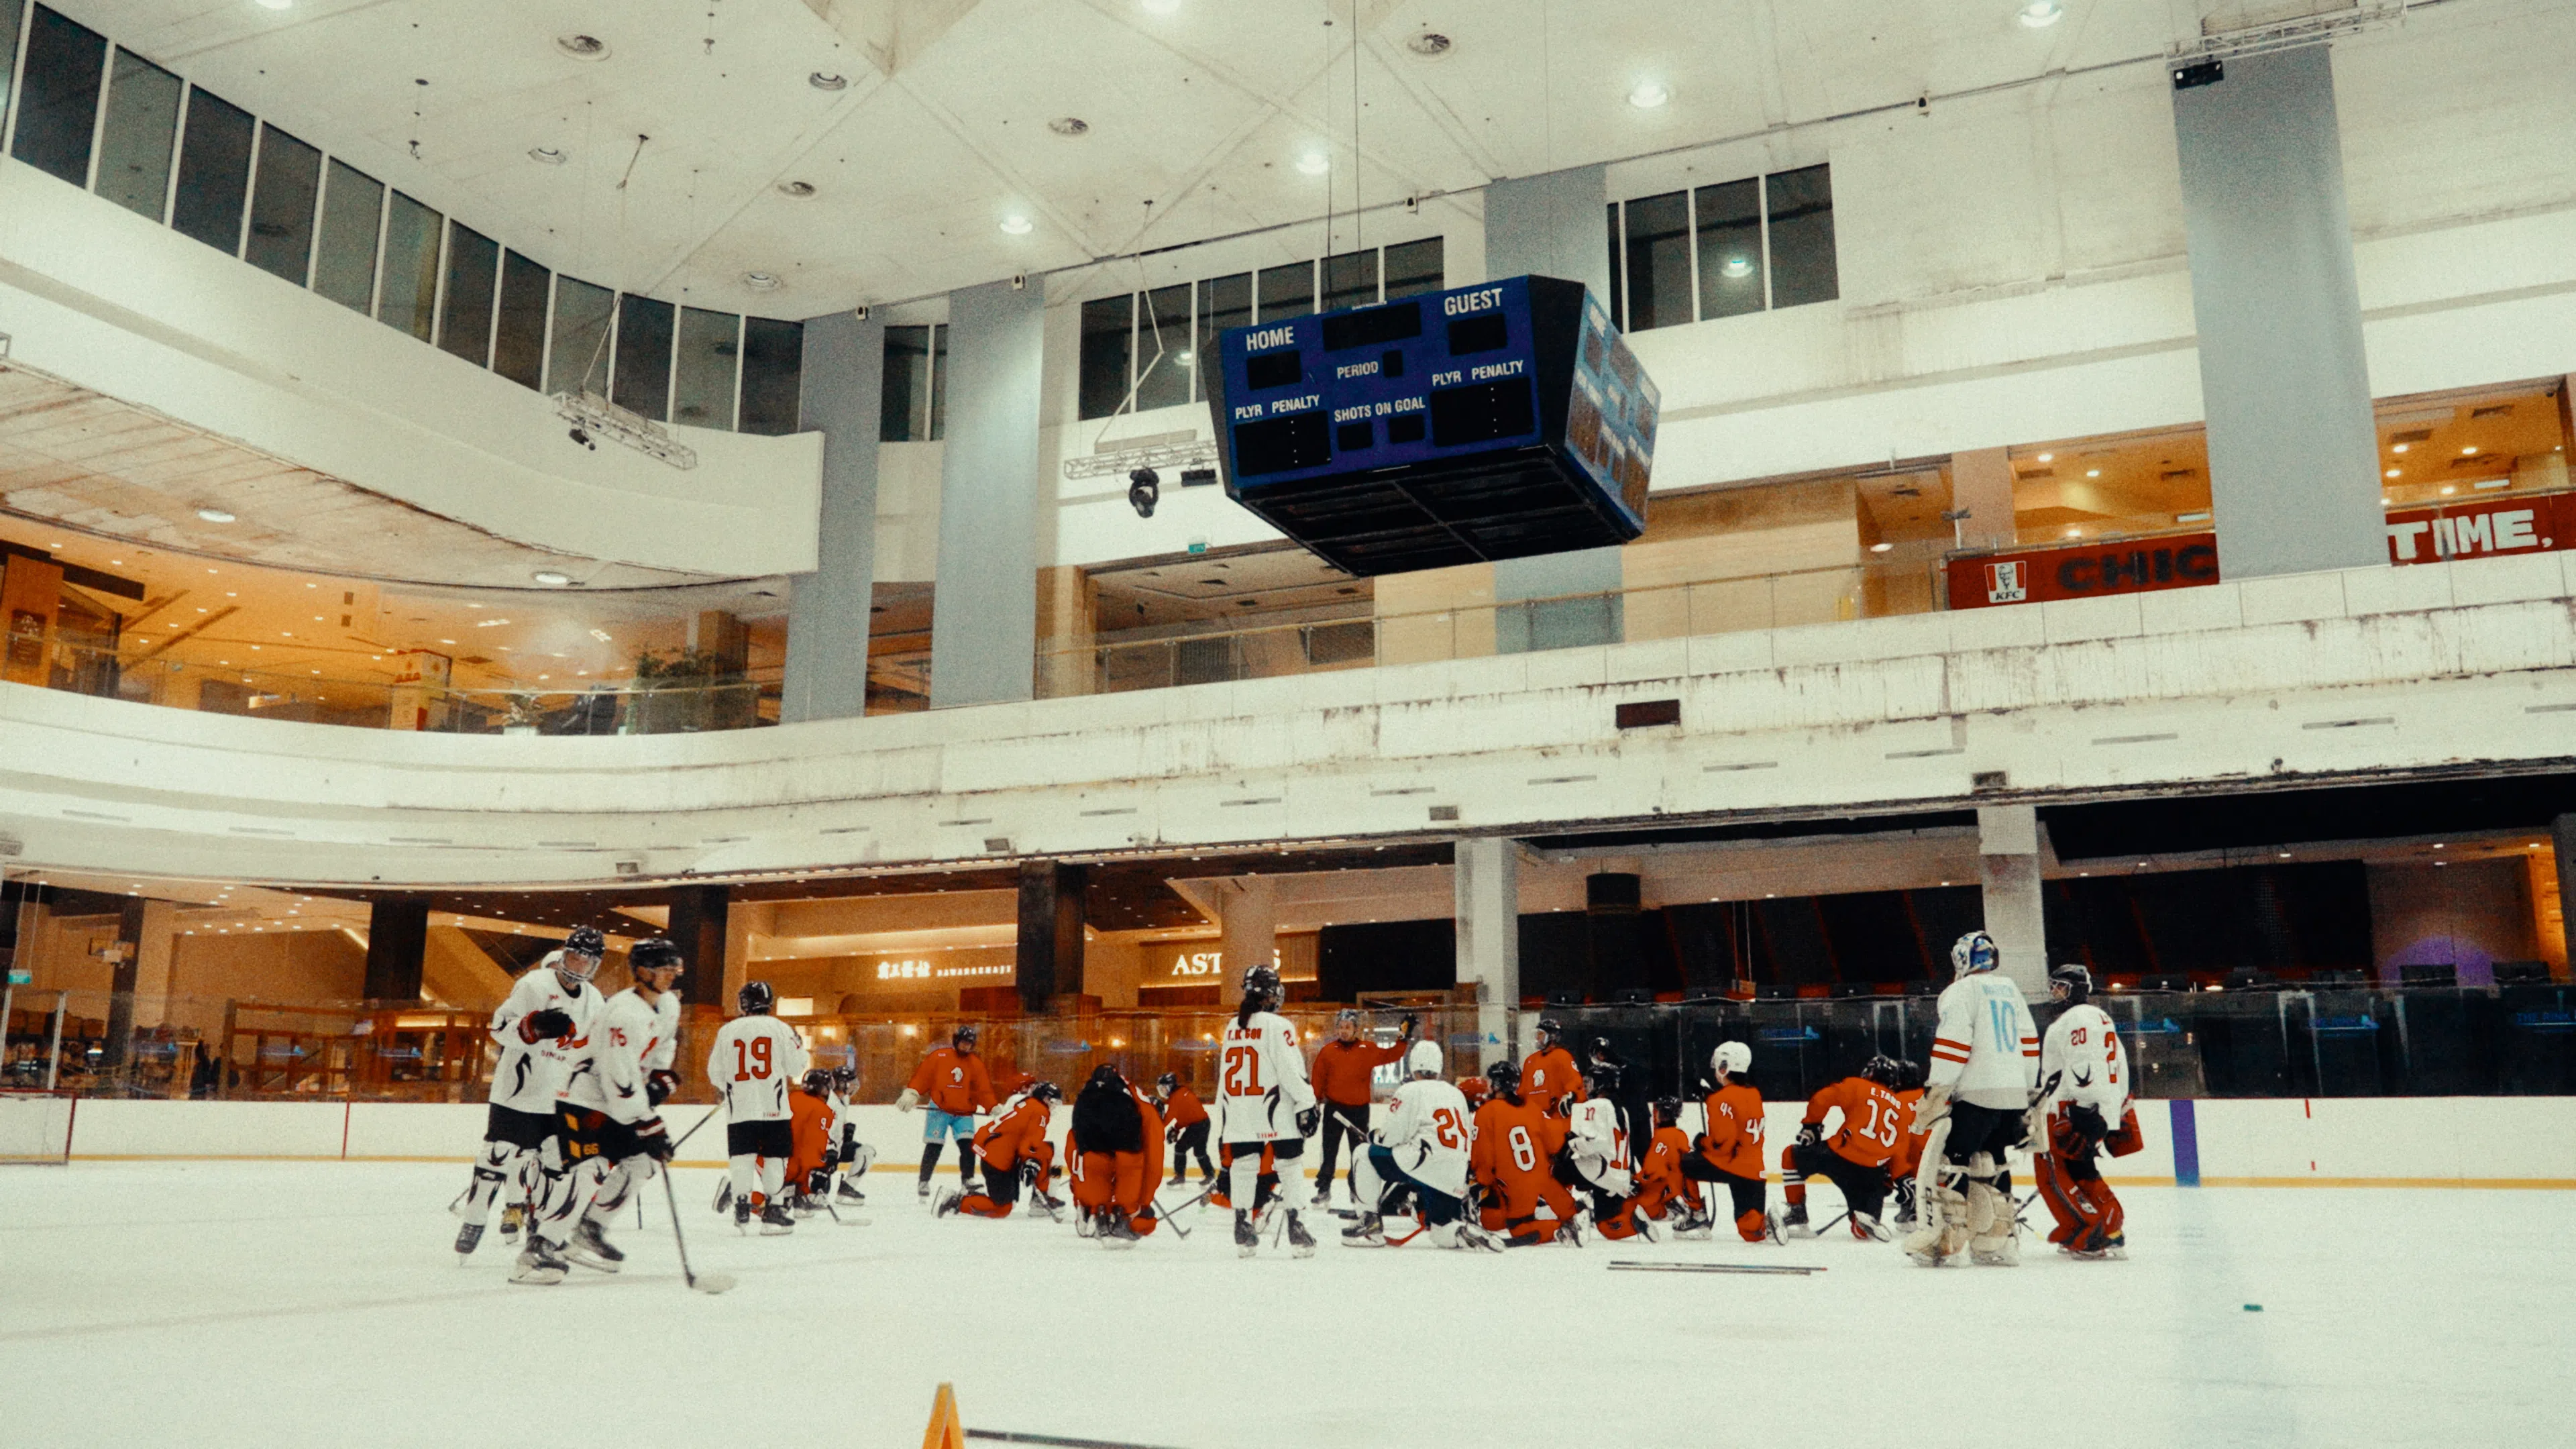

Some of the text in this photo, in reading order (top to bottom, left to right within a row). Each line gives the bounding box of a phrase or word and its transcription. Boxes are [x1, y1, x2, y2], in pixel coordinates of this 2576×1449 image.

[1444, 288, 1503, 317] GUEST
[1246, 327, 1295, 352] HOME
[1337, 361, 1379, 379] PERIOD
[1432, 360, 1524, 386] PLYR PENALTY
[1235, 394, 1320, 419] PLYR PENALTY
[1334, 396, 1426, 422] SHOTS ON GOAL
[1995, 590, 2021, 600] KFC
[1990, 999, 2017, 1053] 10
[2071, 1027, 2087, 1046] 20
[734, 1036, 772, 1081] 19
[2104, 1031, 2118, 1083] 2
[1225, 1046, 1265, 1096] 21
[1860, 1099, 1900, 1148] 15
[1509, 1126, 1536, 1172] 8
[1655, 1142, 1668, 1157] 87
[1925, 1187, 1933, 1227] CCM
